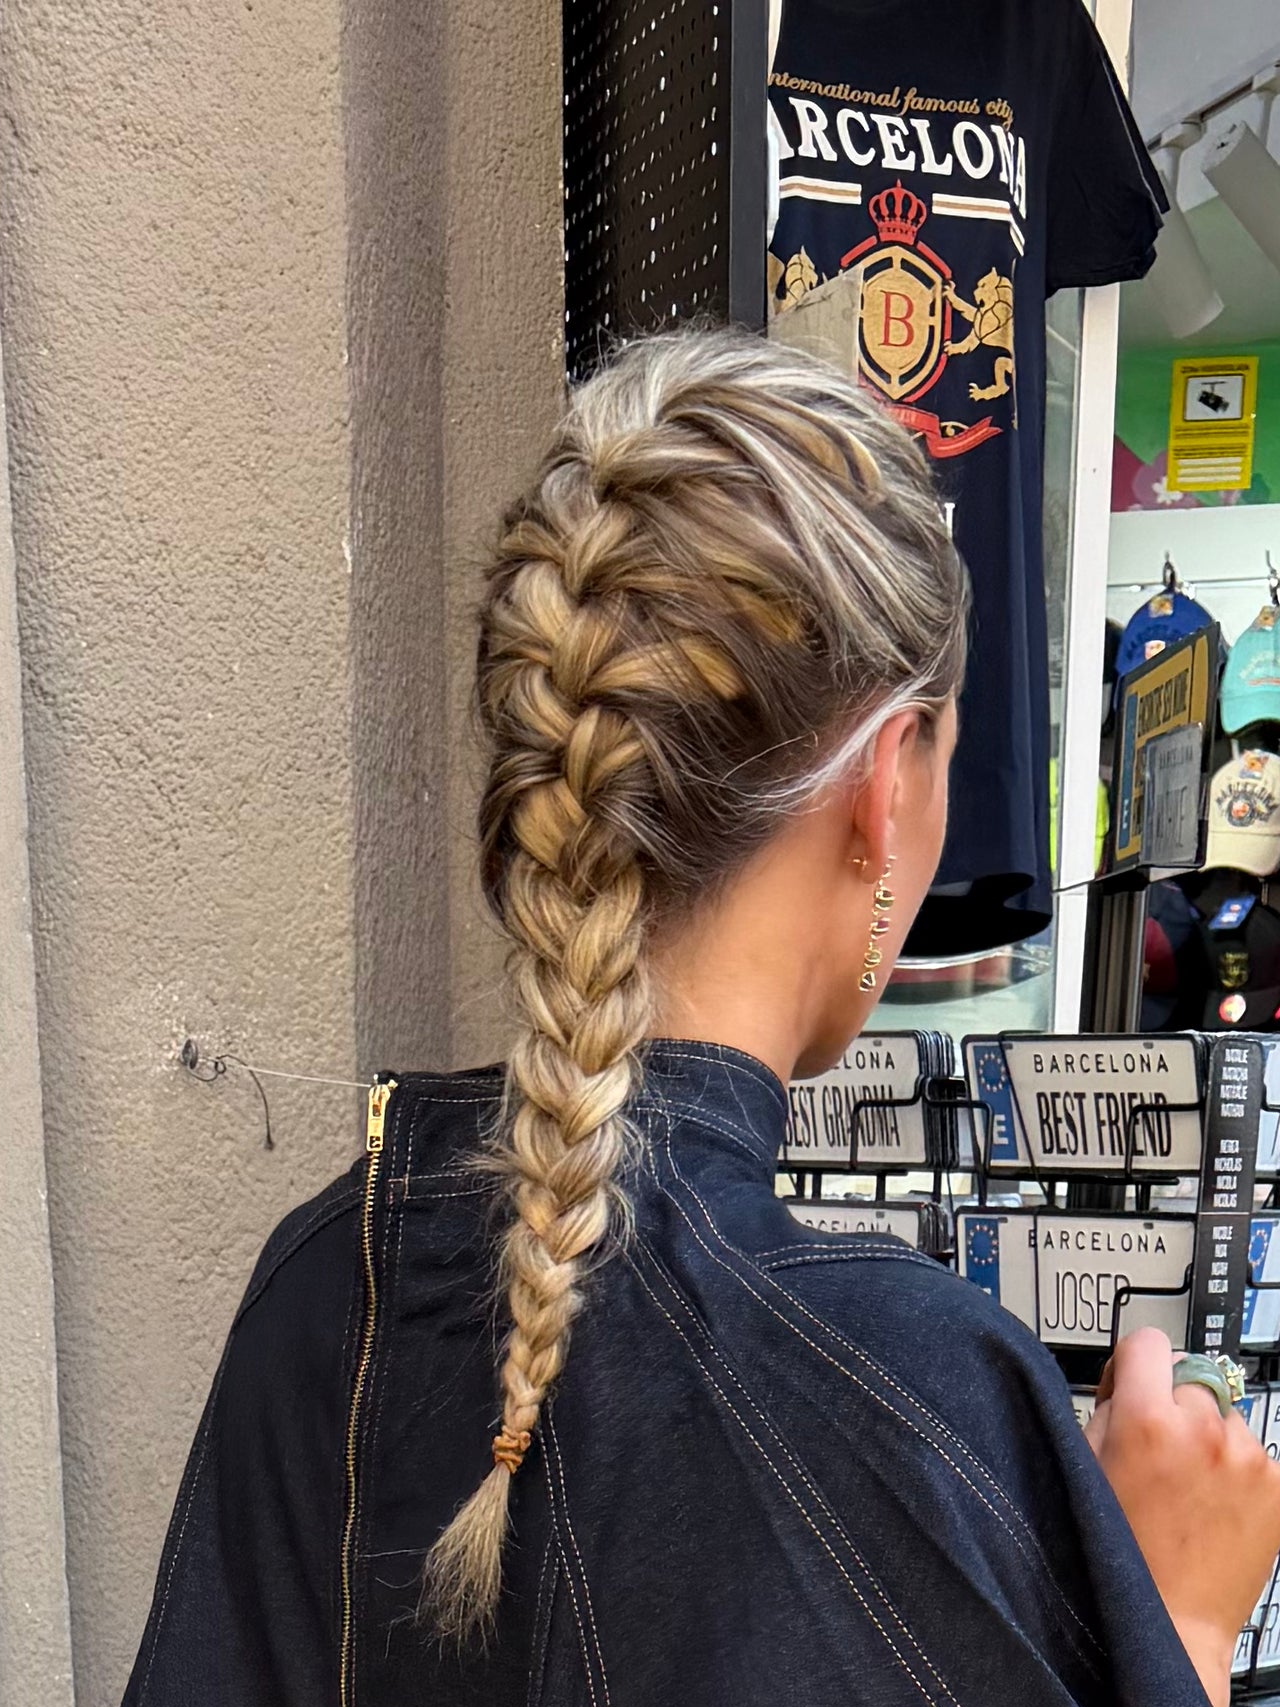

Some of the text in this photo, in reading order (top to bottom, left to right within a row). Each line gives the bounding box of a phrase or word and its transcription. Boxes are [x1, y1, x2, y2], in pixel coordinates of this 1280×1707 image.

[898, 87, 980, 116] famous
[985, 97, 1014, 131] city
[880, 290, 914, 349] B
[1033, 1052, 1169, 1074] BARCELONA
[821, 1083, 901, 1148] GRANDMA
[992, 1114, 1009, 1146] E
[1036, 1091, 1172, 1158] BEST FRIEND
[1028, 1229, 1167, 1254] BARCELONA
